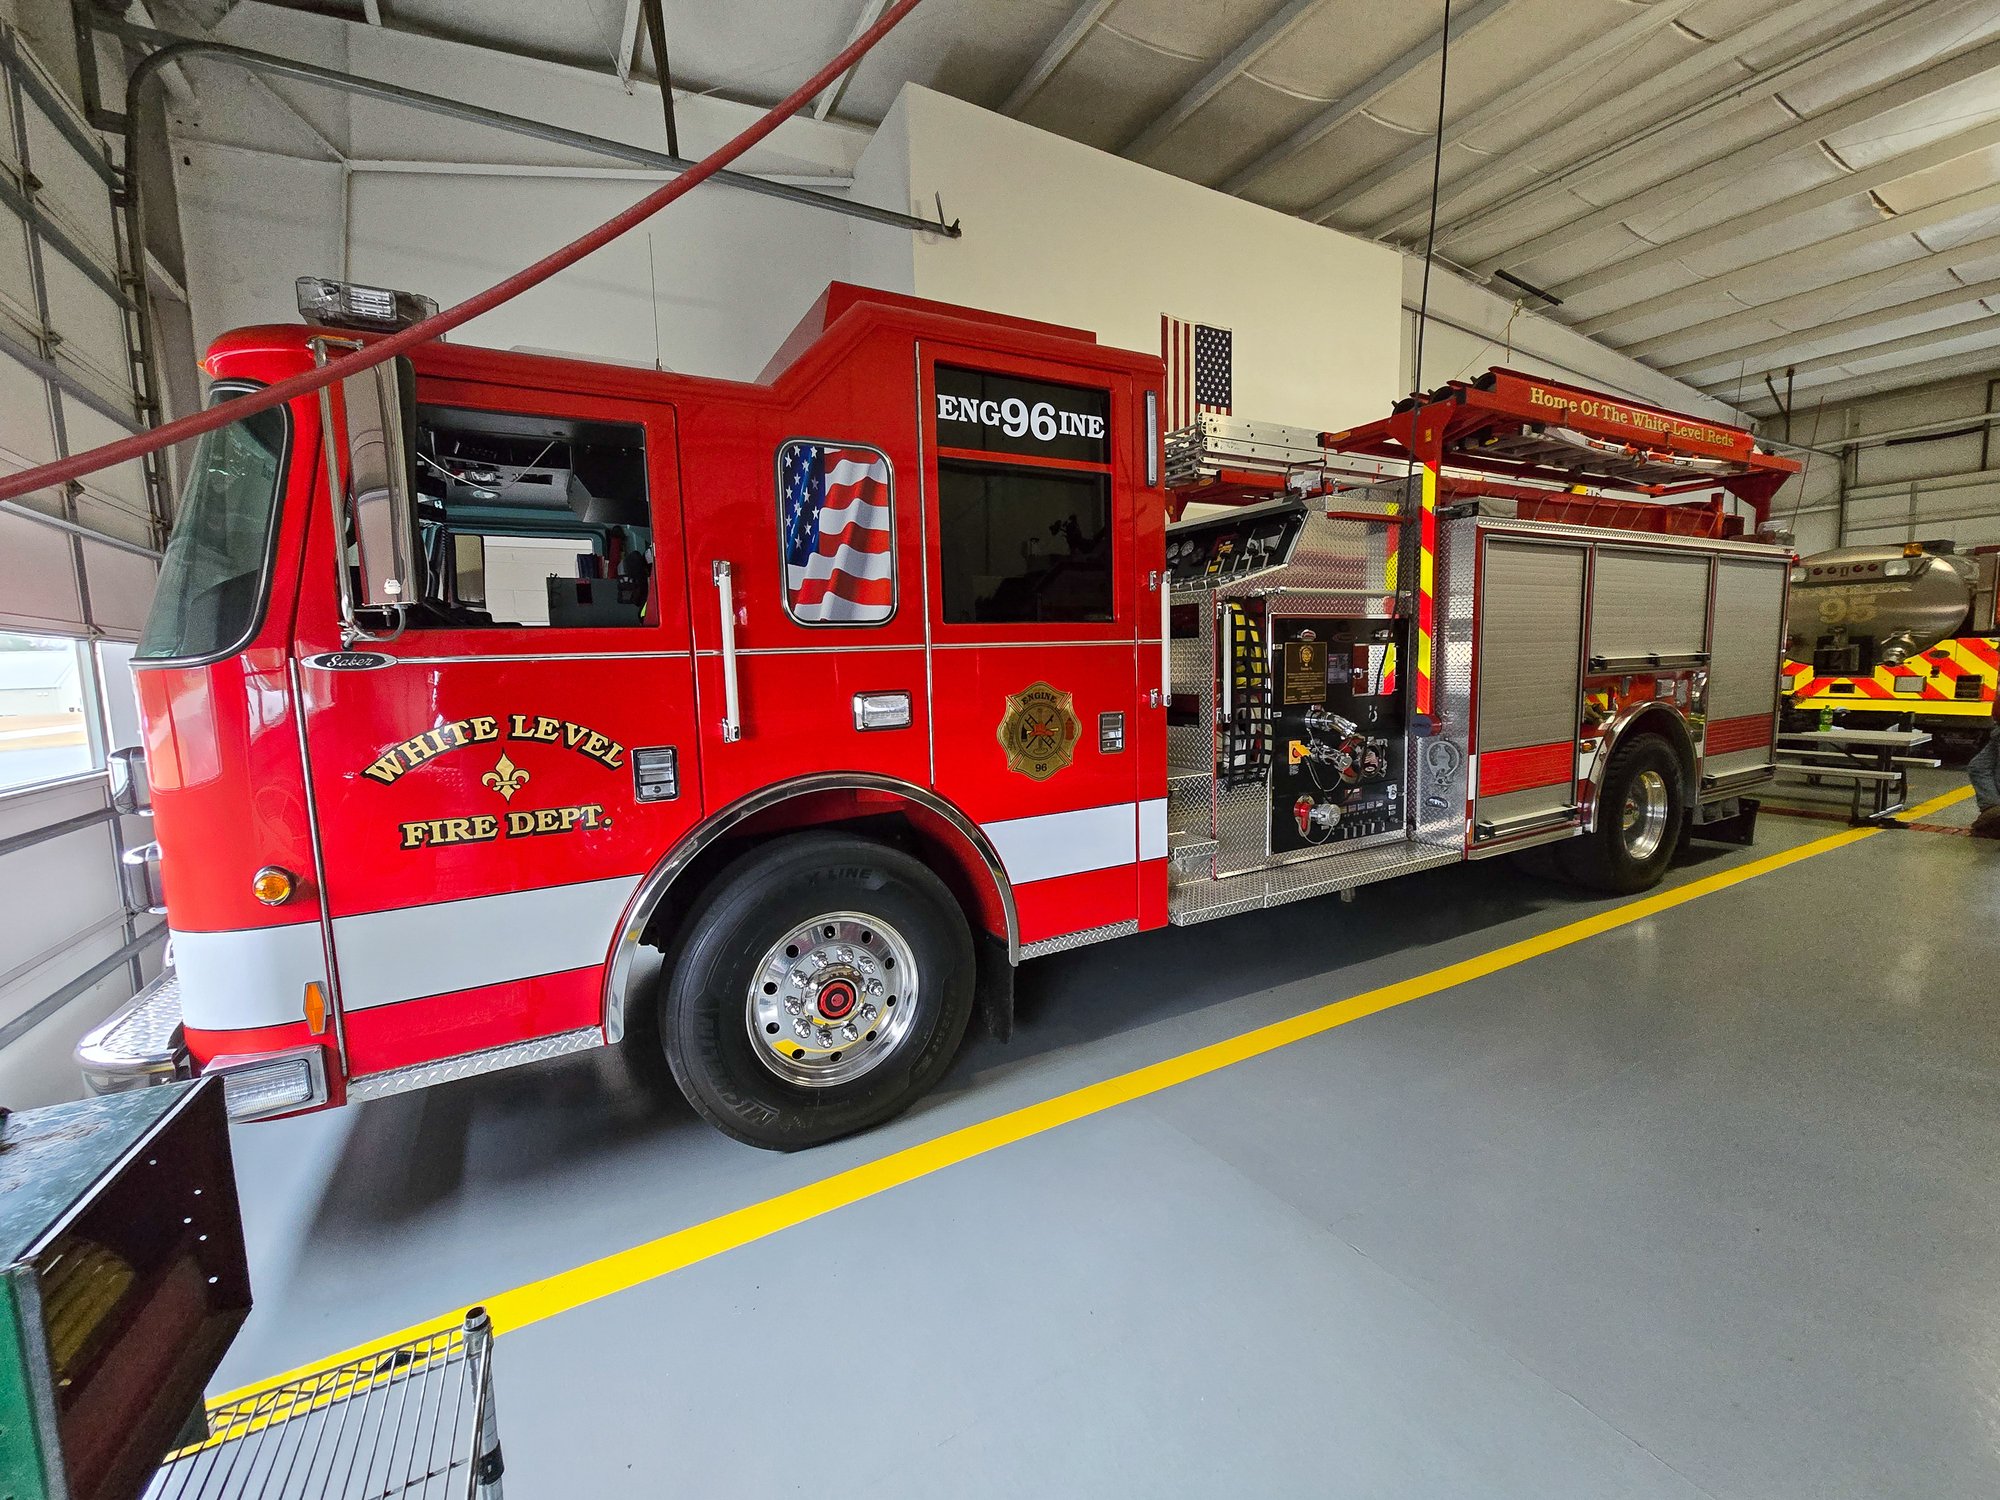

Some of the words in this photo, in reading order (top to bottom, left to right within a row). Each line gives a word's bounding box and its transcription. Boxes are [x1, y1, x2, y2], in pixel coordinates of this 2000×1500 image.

[1530, 387, 1578, 412] Home
[1580, 400, 1601, 417] Of
[1601, 405, 1628, 424] The
[1631, 411, 1671, 432] White
[1672, 421, 1705, 442] Level
[1707, 429, 1735, 447] Reds
[326, 654, 374, 668] Saber
[1021, 692, 1057, 706] ENGINE
[361, 716, 500, 786] WHITE
[508, 714, 625, 771] LEVEL
[1035, 763, 1048, 773] 96
[400, 815, 498, 849] FIRE
[505, 804, 613, 839] DEPT.
